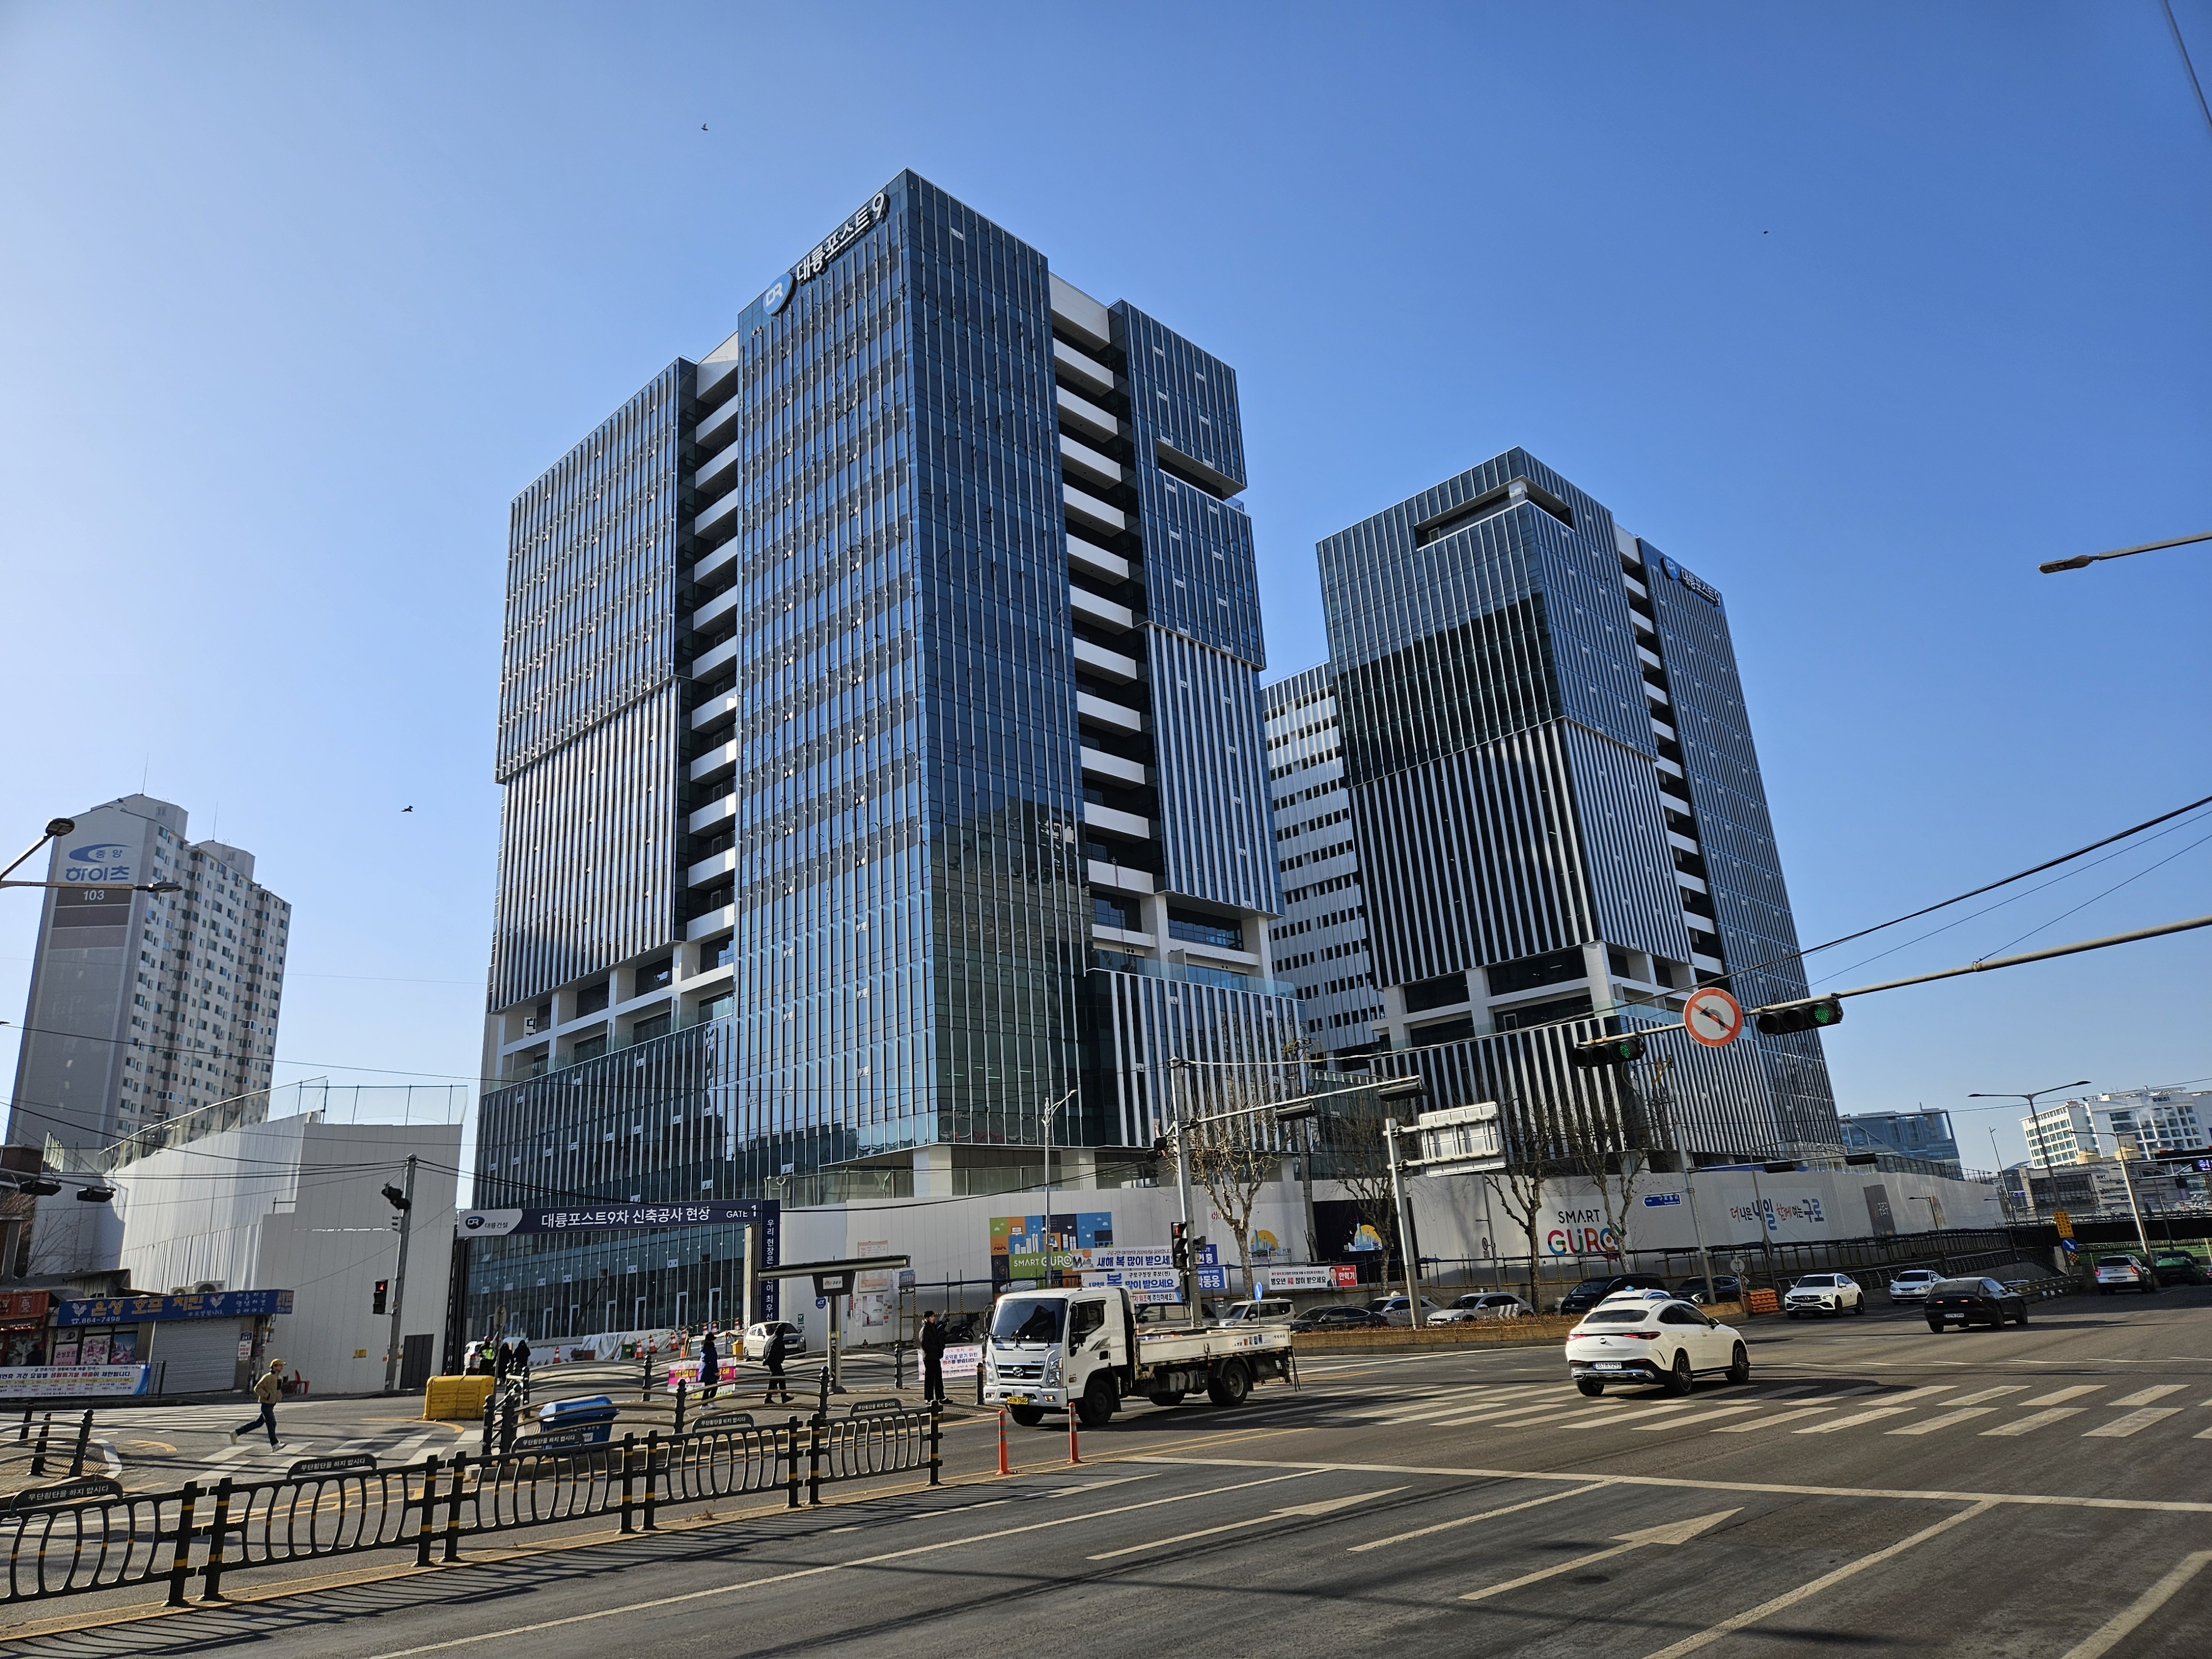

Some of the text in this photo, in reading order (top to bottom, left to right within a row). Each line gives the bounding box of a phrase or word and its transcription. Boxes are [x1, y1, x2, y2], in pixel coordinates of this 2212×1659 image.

[796, 192, 885, 281] 대륭포스트9
[1681, 568, 1720, 606] 대륭포스트9
[96, 849, 123, 858] 중앙
[65, 865, 130, 881] 하이츠
[83, 890, 105, 901] 103
[541, 1209, 629, 1228] 대륭포스트9차
[632, 1207, 683, 1224] 신축공사
[686, 1206, 711, 1221] 현장
[752, 1205, 757, 1217] 1
[1558, 1209, 1600, 1224] SMART
[1730, 1206, 1740, 1223] 더
[1740, 1207, 1753, 1220] 나은
[1751, 1198, 1778, 1230] 내일
[1802, 1198, 1824, 1223] 구로
[767, 1219, 774, 1236] 우리
[1014, 1259, 1039, 1267] SMART
[1097, 1255, 1173, 1267] 새해 복 많이 받으세
[1142, 1279, 1174, 1288] 받으세요
[132, 1298, 163, 1314] 호프
[173, 1295, 204, 1311] 치킨
[765, 1295, 774, 1321] 최우선
[300, 1461, 332, 1471] 무단횡단을
[347, 1457, 366, 1466] 맙시다
[28, 1490, 67, 1501] 무단횡단을
[86, 1485, 109, 1495] 맙시다
